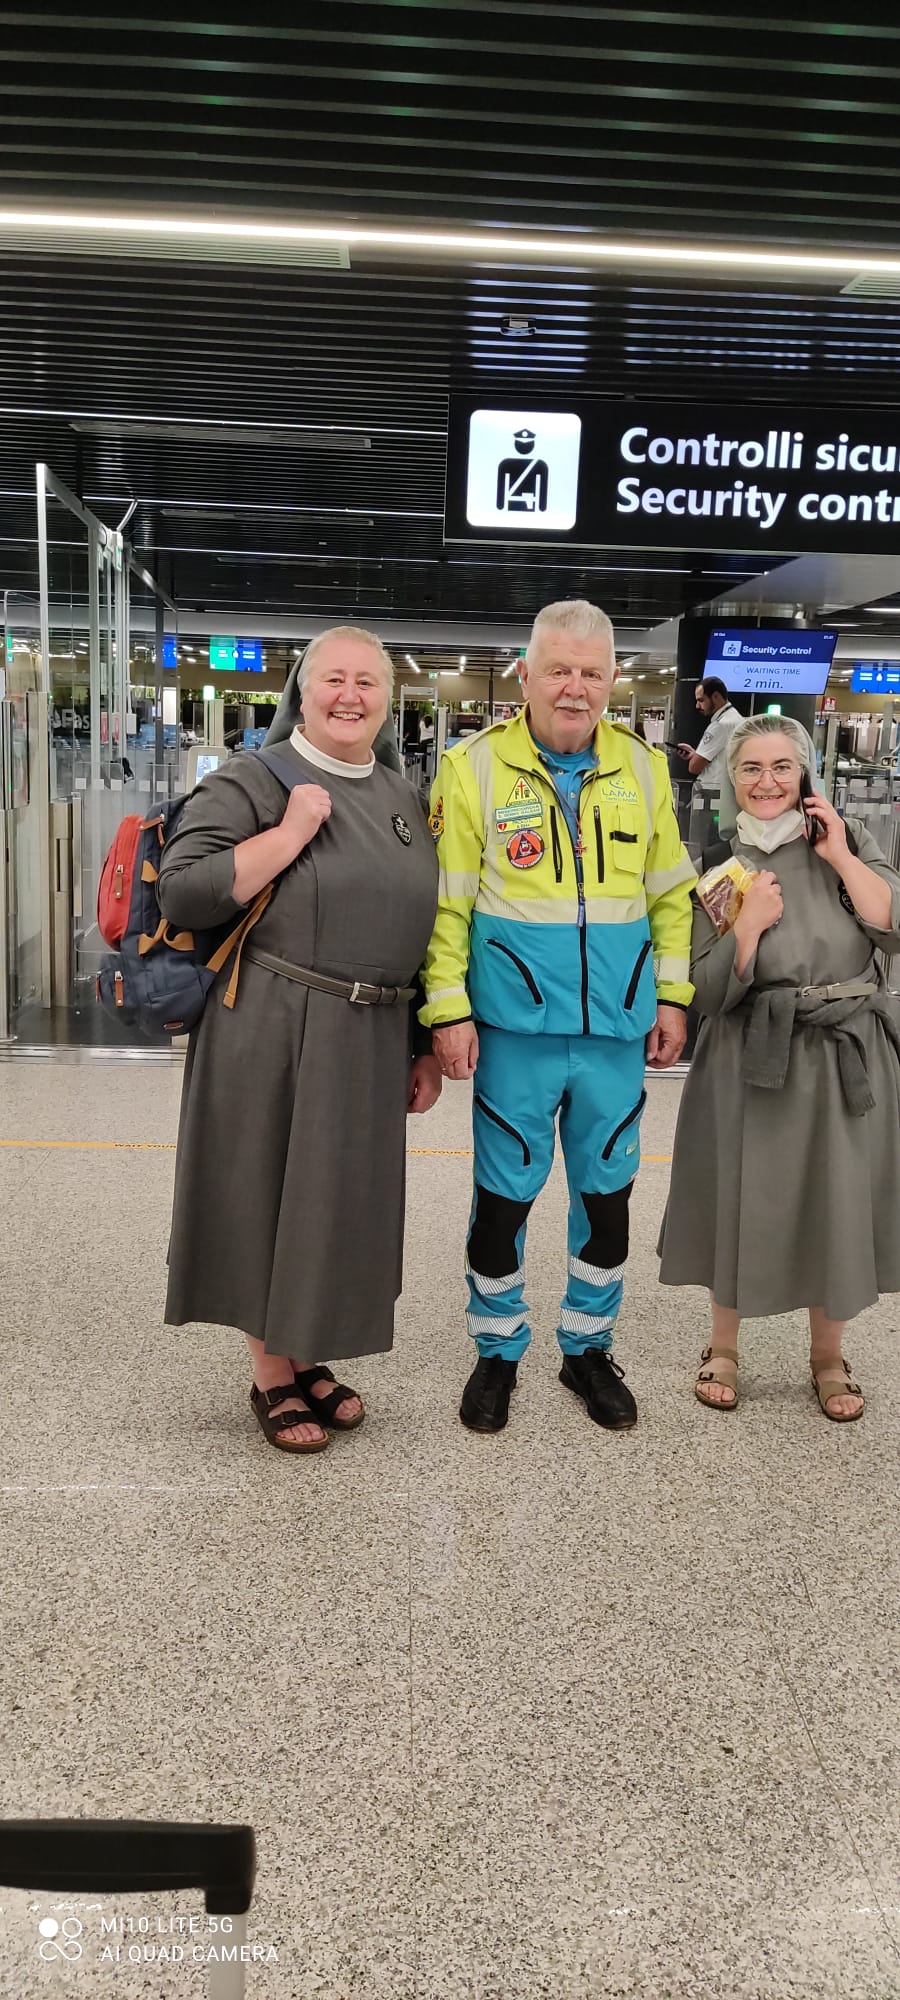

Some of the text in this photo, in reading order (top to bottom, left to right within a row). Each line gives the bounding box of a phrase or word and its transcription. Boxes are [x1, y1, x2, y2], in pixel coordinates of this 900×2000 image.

[620, 427, 900, 473] Controlli sicu
[616, 477, 786, 529] Security
[742, 645, 811, 656] Security Control
[747, 666, 780, 675] WAITING
[744, 678, 783, 689] 2 min.
